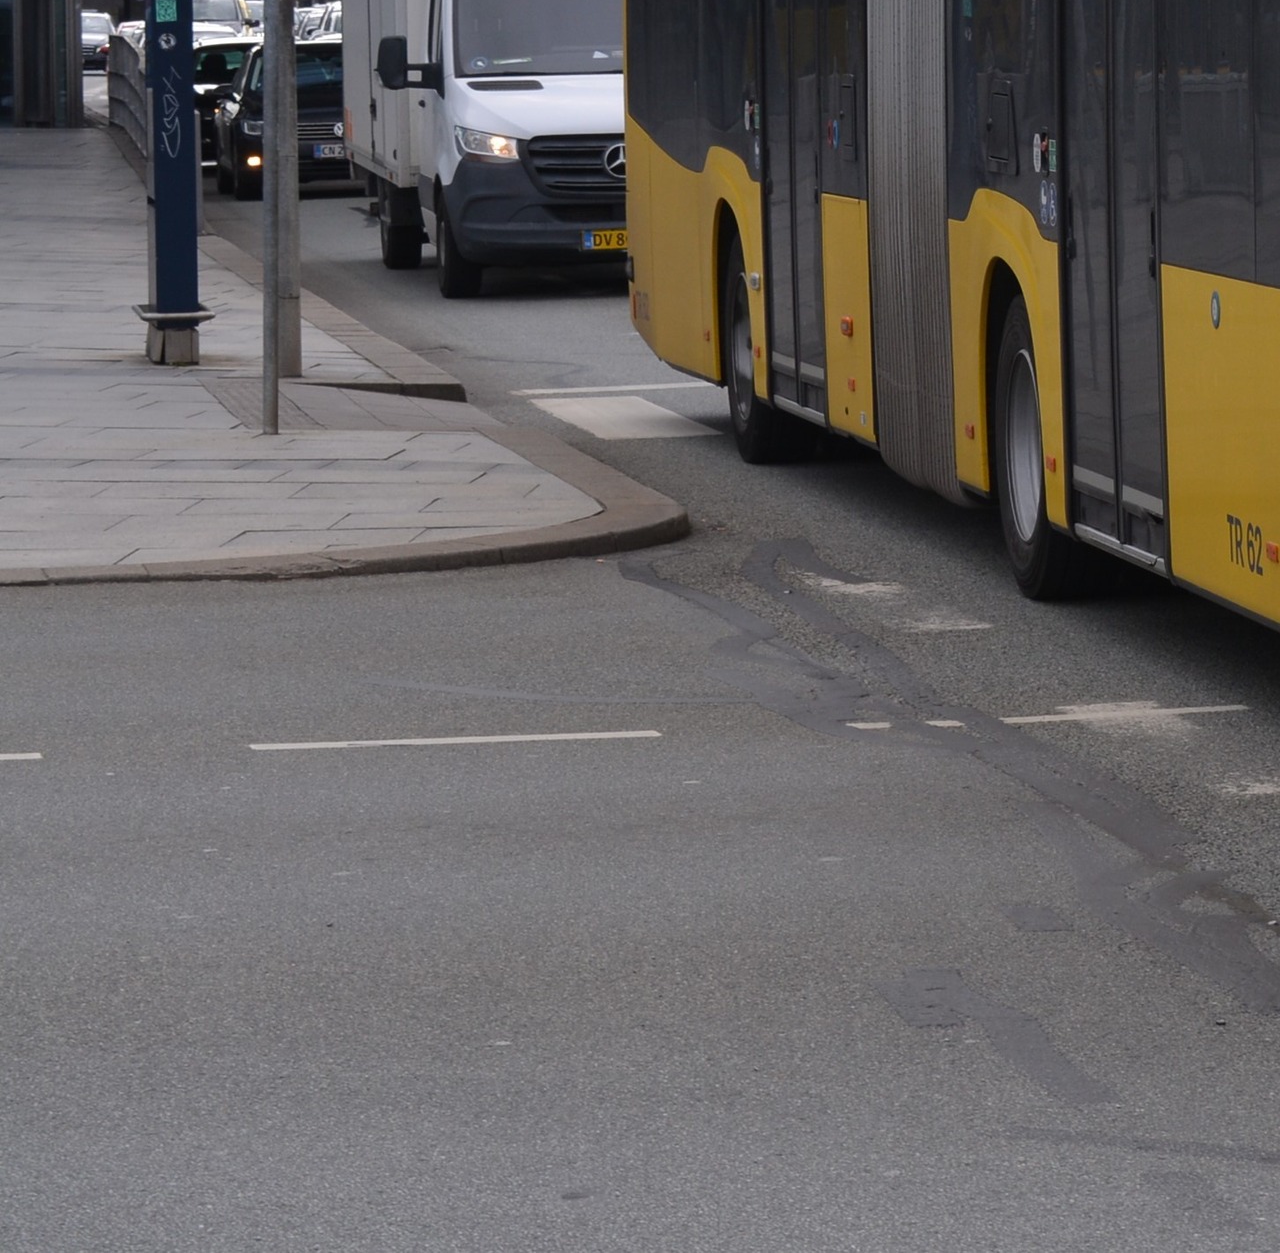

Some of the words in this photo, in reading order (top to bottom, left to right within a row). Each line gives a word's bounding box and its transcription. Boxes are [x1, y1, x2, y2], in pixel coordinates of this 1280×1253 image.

[322, 146, 335, 156] CN
[593, 233, 612, 247] DV
[616, 232, 628, 247] 8
[1226, 513, 1245, 568] TR
[1246, 521, 1264, 577] 62
